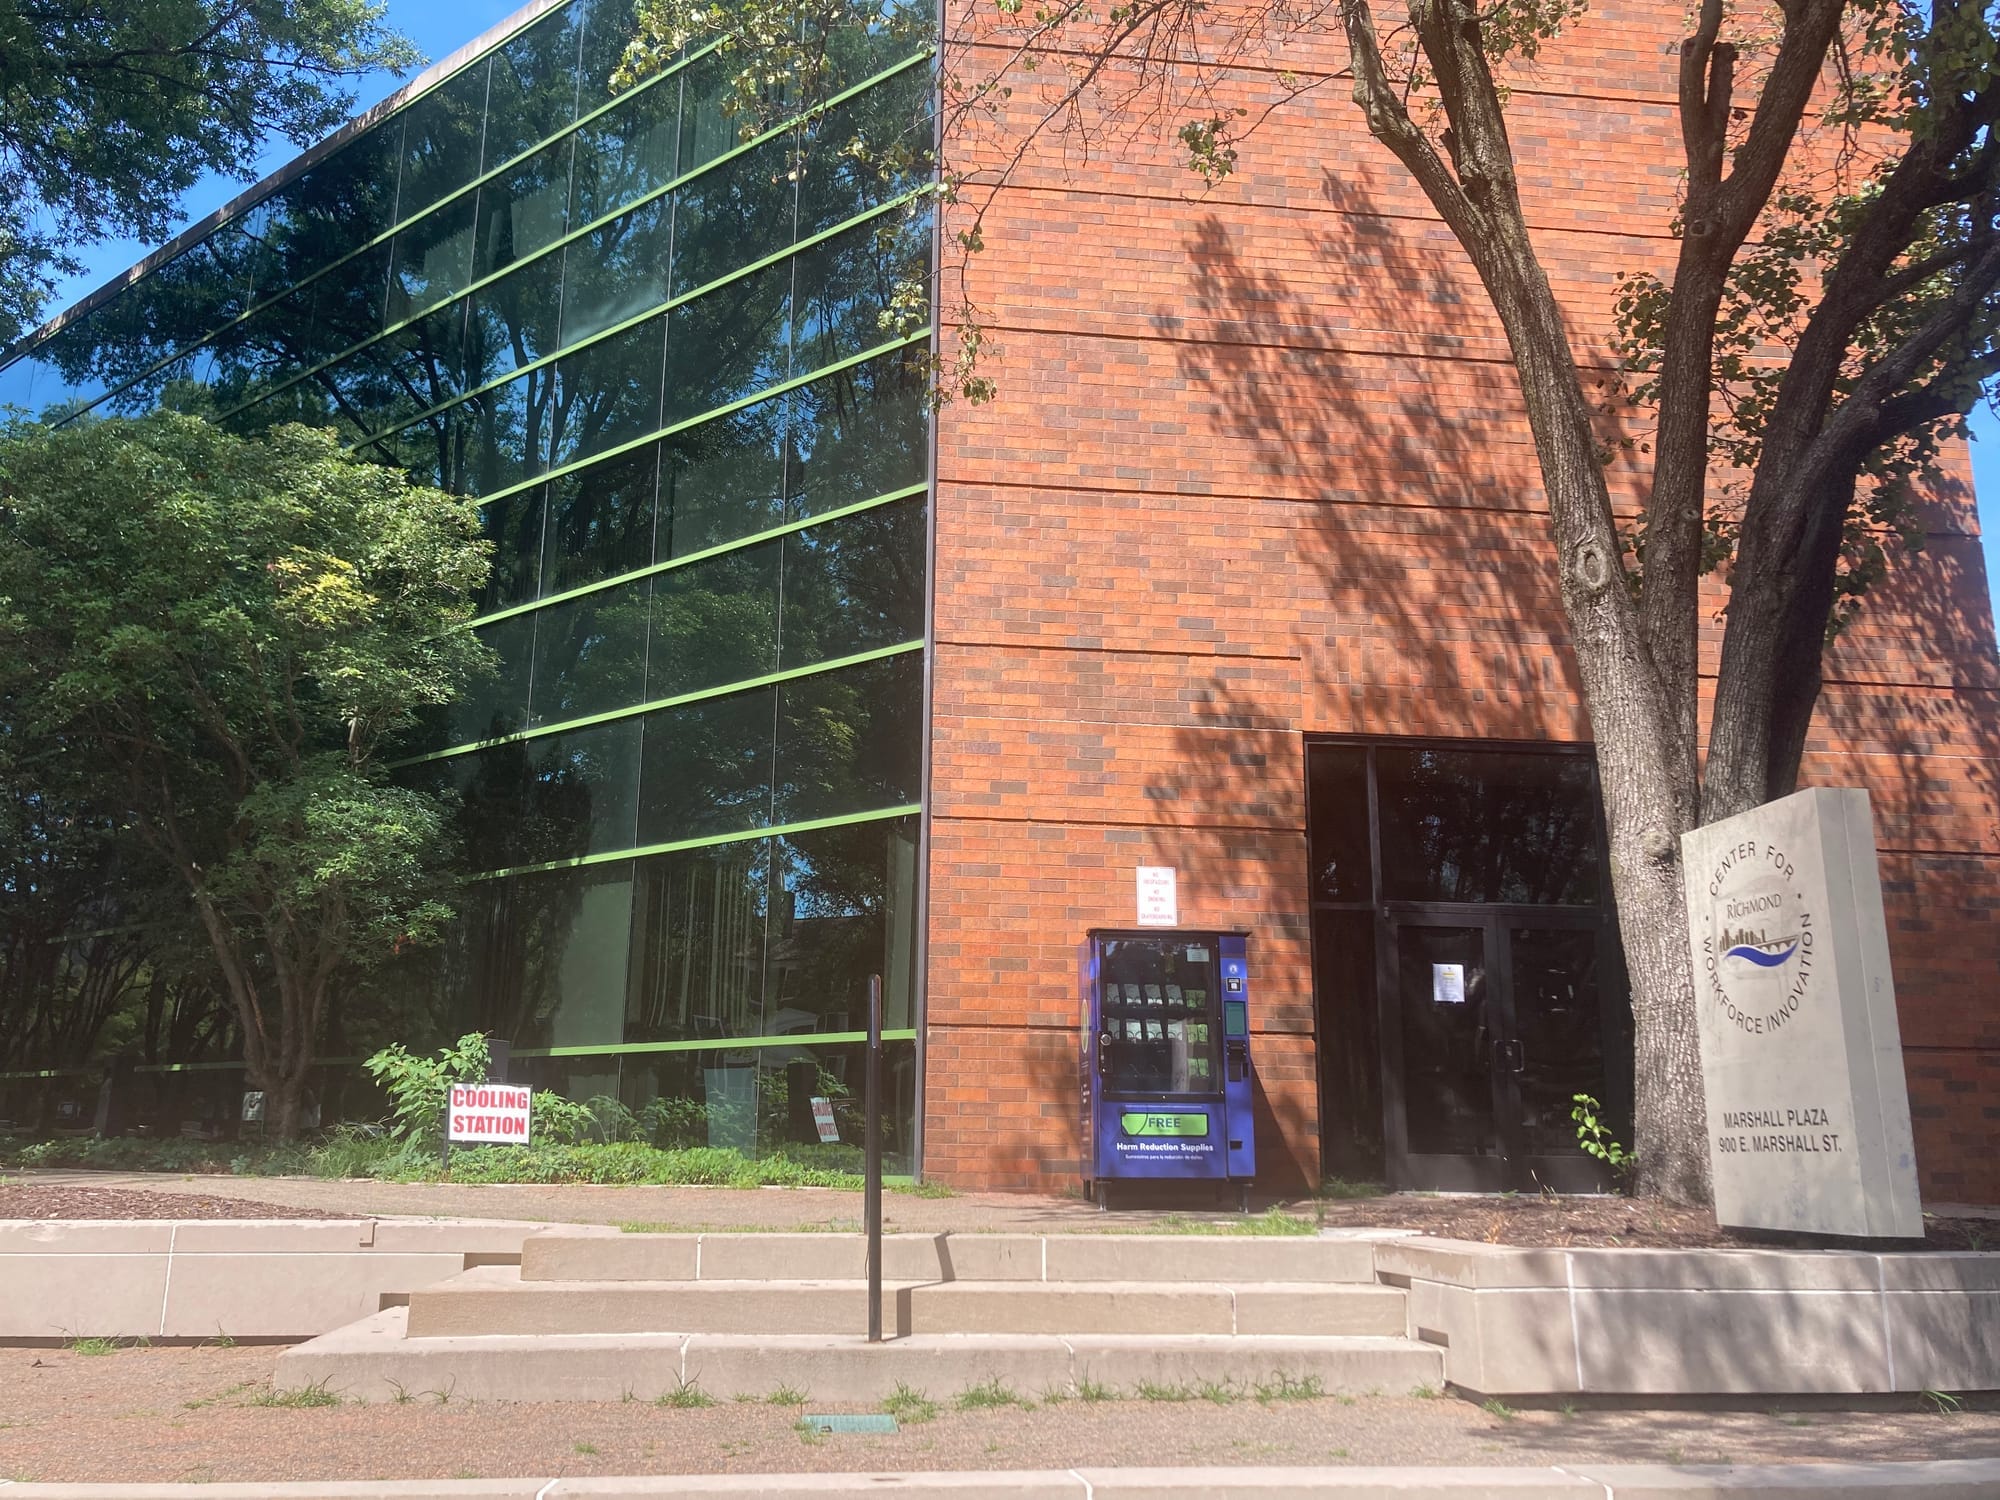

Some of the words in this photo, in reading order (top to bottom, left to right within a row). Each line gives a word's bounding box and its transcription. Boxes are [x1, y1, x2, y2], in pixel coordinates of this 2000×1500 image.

[1709, 841, 1756, 897] CENTER
[1765, 845, 1795, 882] FOR
[1703, 936, 1764, 1034] WORKFORCE
[1766, 912, 1814, 1032] INNOVATION
[453, 1089, 528, 1109] COOLING
[453, 1115, 525, 1135] STATION
[1148, 1117, 1182, 1128] FREE
[1723, 1110, 1785, 1128] MARSHALL
[1787, 1108, 1830, 1127] PLAZA
[1116, 1142, 1138, 1151] Harm
[1140, 1142, 1179, 1151] Reduction
[1180, 1143, 1214, 1153] Supplies
[1719, 1137, 1737, 1152] 900
[1739, 1136, 1751, 1152] E.
[1752, 1135, 1819, 1152] MARSHALL
[1823, 1134, 1843, 1152] ST.
